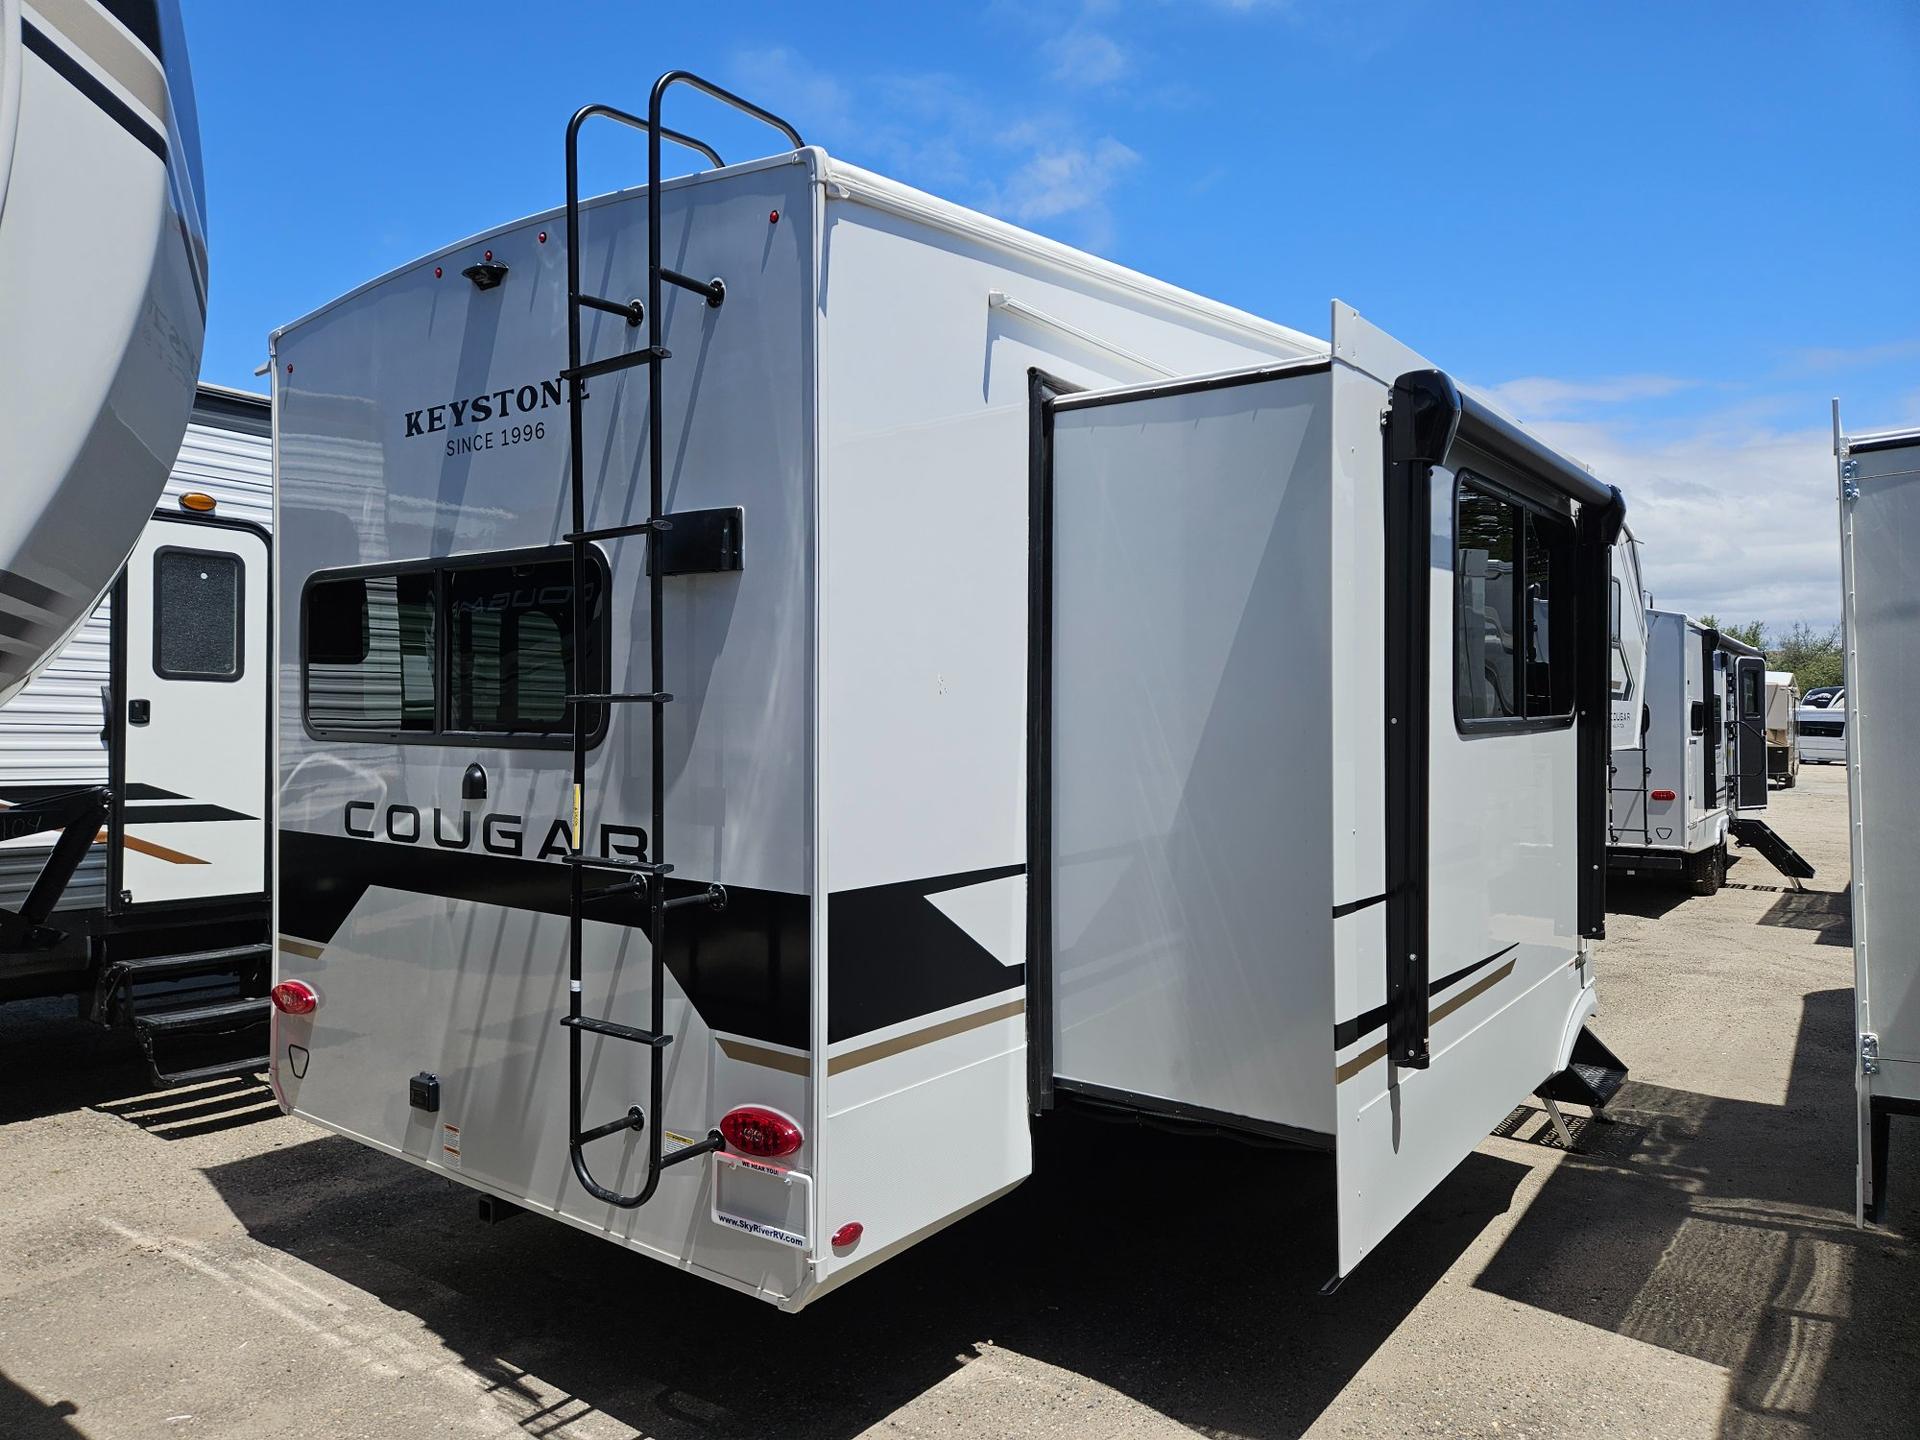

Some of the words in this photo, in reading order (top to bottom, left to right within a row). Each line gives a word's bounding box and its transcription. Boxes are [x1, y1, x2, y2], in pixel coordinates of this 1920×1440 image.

[447, 432, 493, 456] SINCE
[501, 422, 545, 446] 1996
[345, 800, 648, 863] COUGAR
[718, 1214, 803, 1246] www.SkyRiverRV.com
